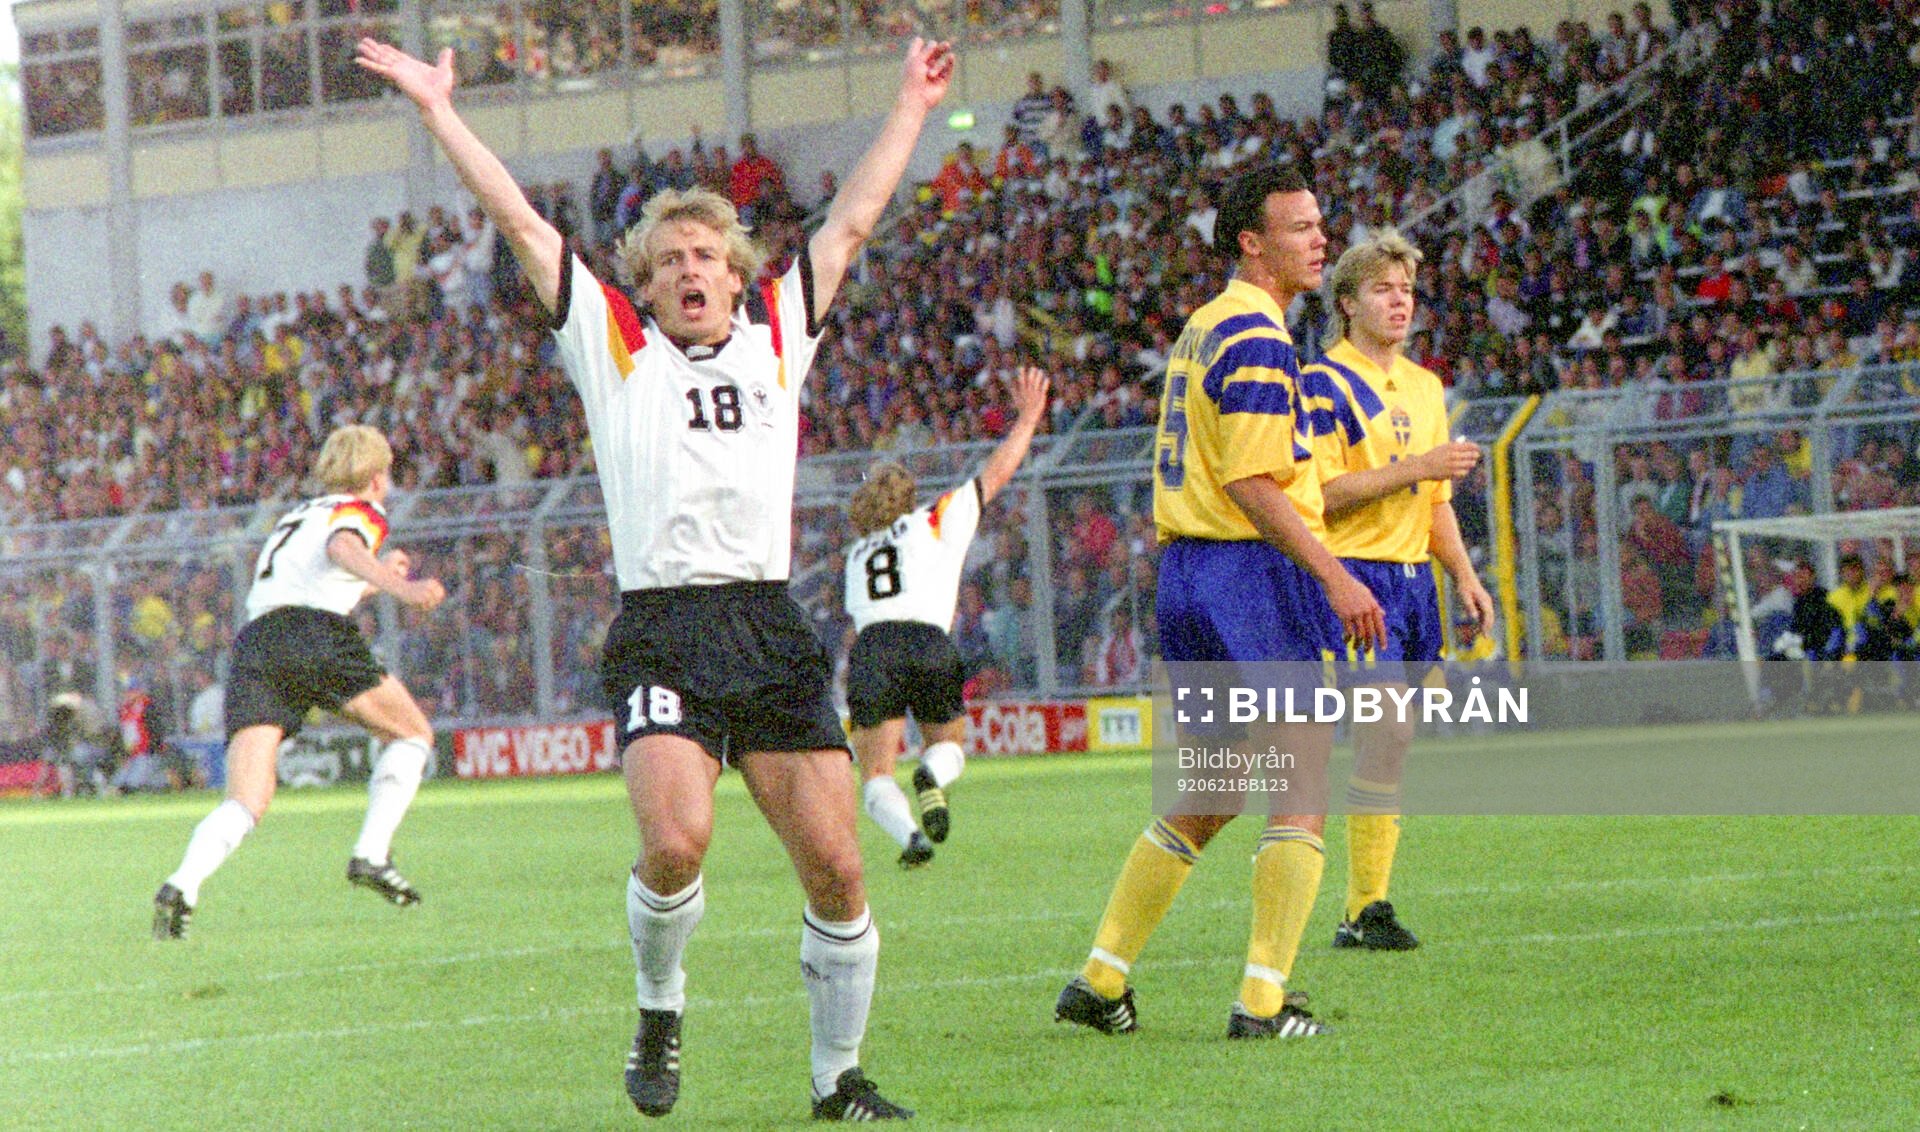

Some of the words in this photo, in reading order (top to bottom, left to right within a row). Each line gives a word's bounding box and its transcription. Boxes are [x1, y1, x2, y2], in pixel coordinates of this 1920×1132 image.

[686, 384, 745, 433] 18
[1157, 371, 1190, 491] 5
[258, 518, 305, 580] 7
[866, 545, 901, 600] 8
[627, 685, 682, 732] 18
[457, 732, 509, 776] JVC
[512, 727, 590, 773] VIDEO
